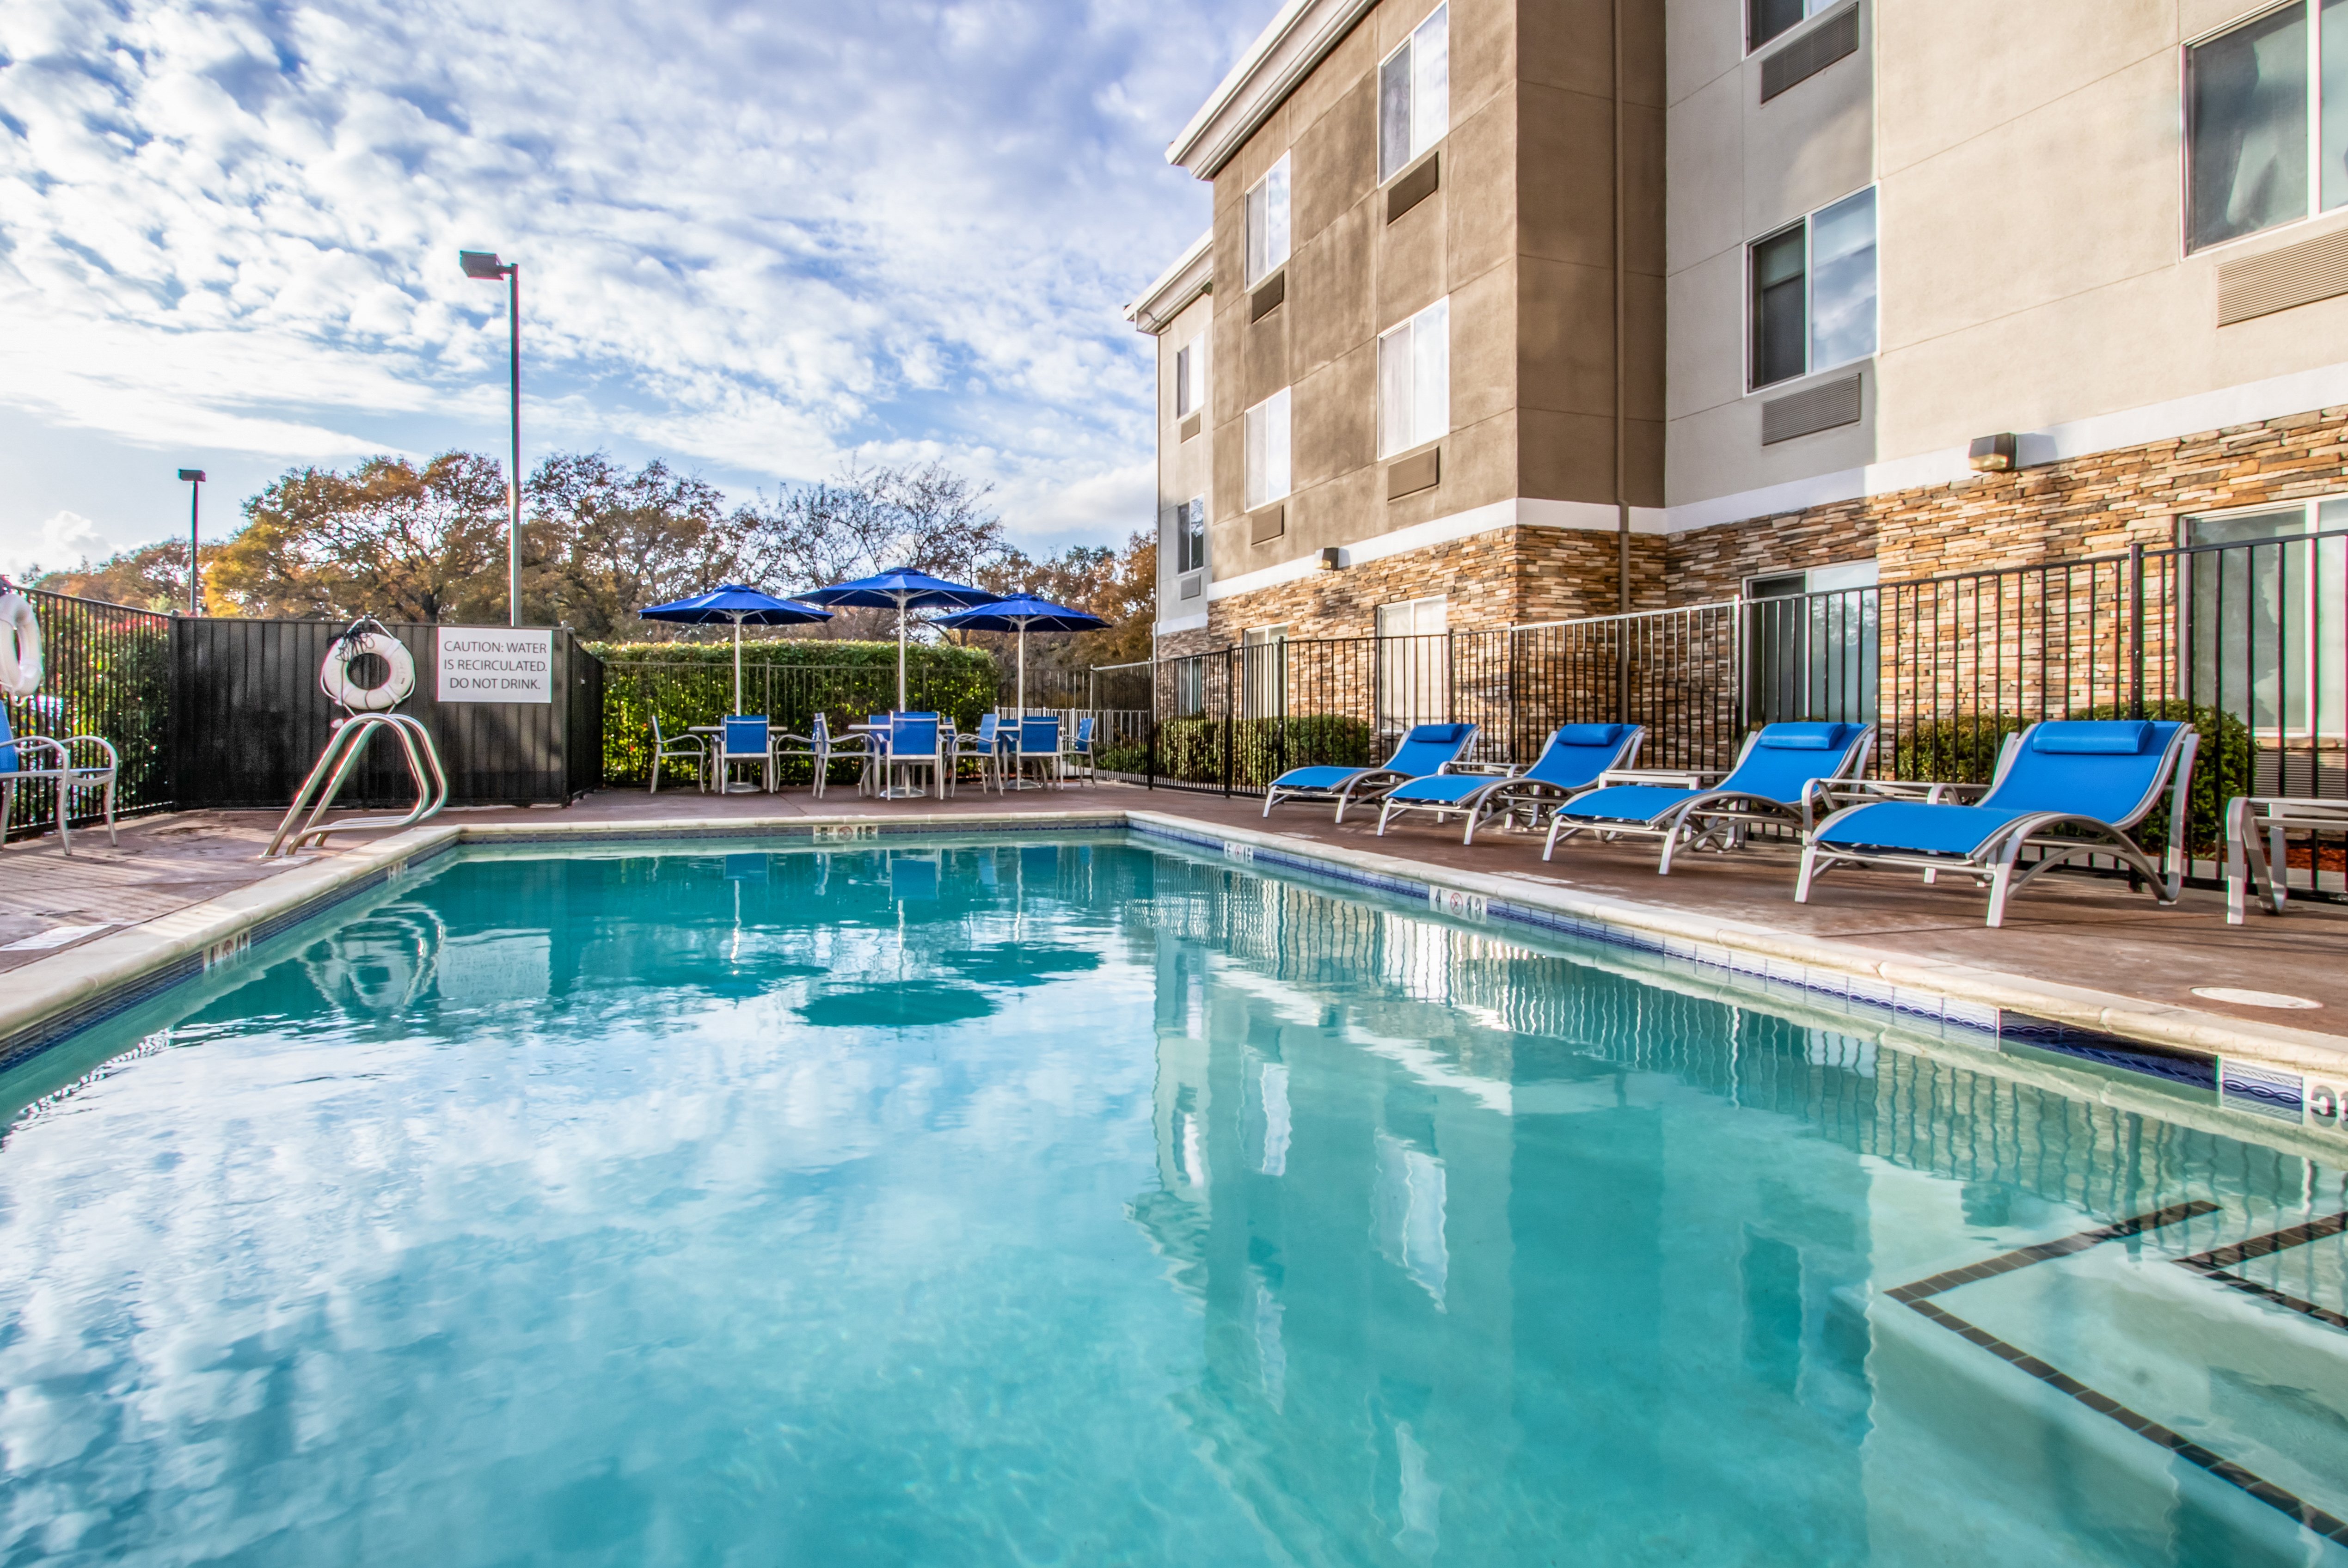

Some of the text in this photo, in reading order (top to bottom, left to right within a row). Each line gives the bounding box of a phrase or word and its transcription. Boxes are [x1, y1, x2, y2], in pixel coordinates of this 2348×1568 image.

[444, 641, 547, 654] CAUTION: WATER
[444, 659, 547, 672] IS RECIRCULATED.
[450, 678, 541, 690] DO NOT DRINK.
